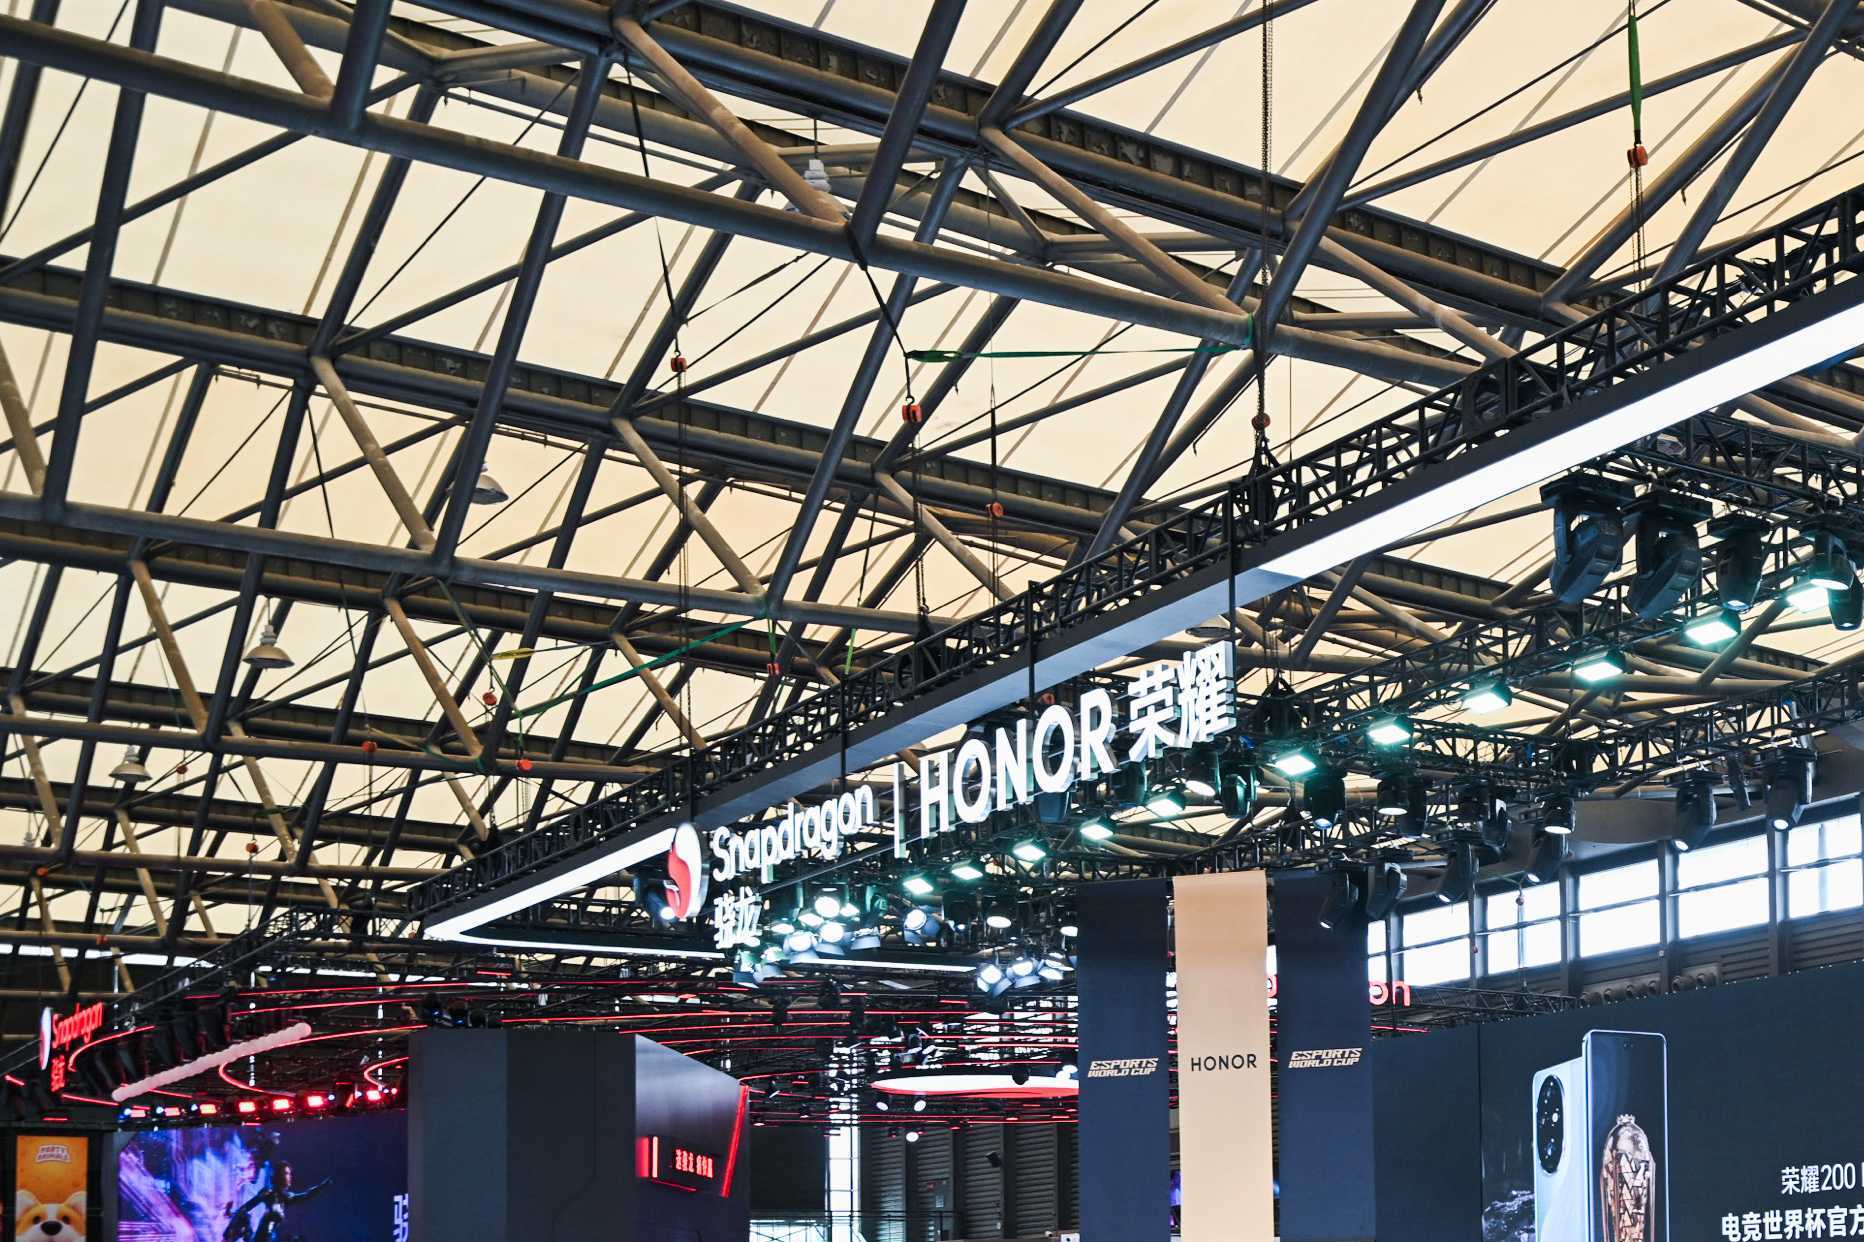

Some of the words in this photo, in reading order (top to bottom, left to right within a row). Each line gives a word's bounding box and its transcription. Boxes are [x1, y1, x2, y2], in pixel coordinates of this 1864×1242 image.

[711, 784, 876, 884] Snapdragon
[919, 687, 1119, 839] HONOR
[1128, 640, 1237, 762] 荣耀
[714, 885, 763, 949] 骁龙
[52, 1002, 103, 1051] Snapdragon
[1191, 1053, 1257, 1072] HONOR
[1288, 1059, 1332, 1068] WORLD
[1332, 1057, 1360, 1067] CUP
[1291, 1047, 1363, 1061] ESPORTS
[1087, 1068, 1130, 1078] WORLD
[1130, 1067, 1156, 1076] CUP
[1090, 1058, 1159, 1071] ESPORTS
[1781, 1163, 1856, 1195] 荣耀200
